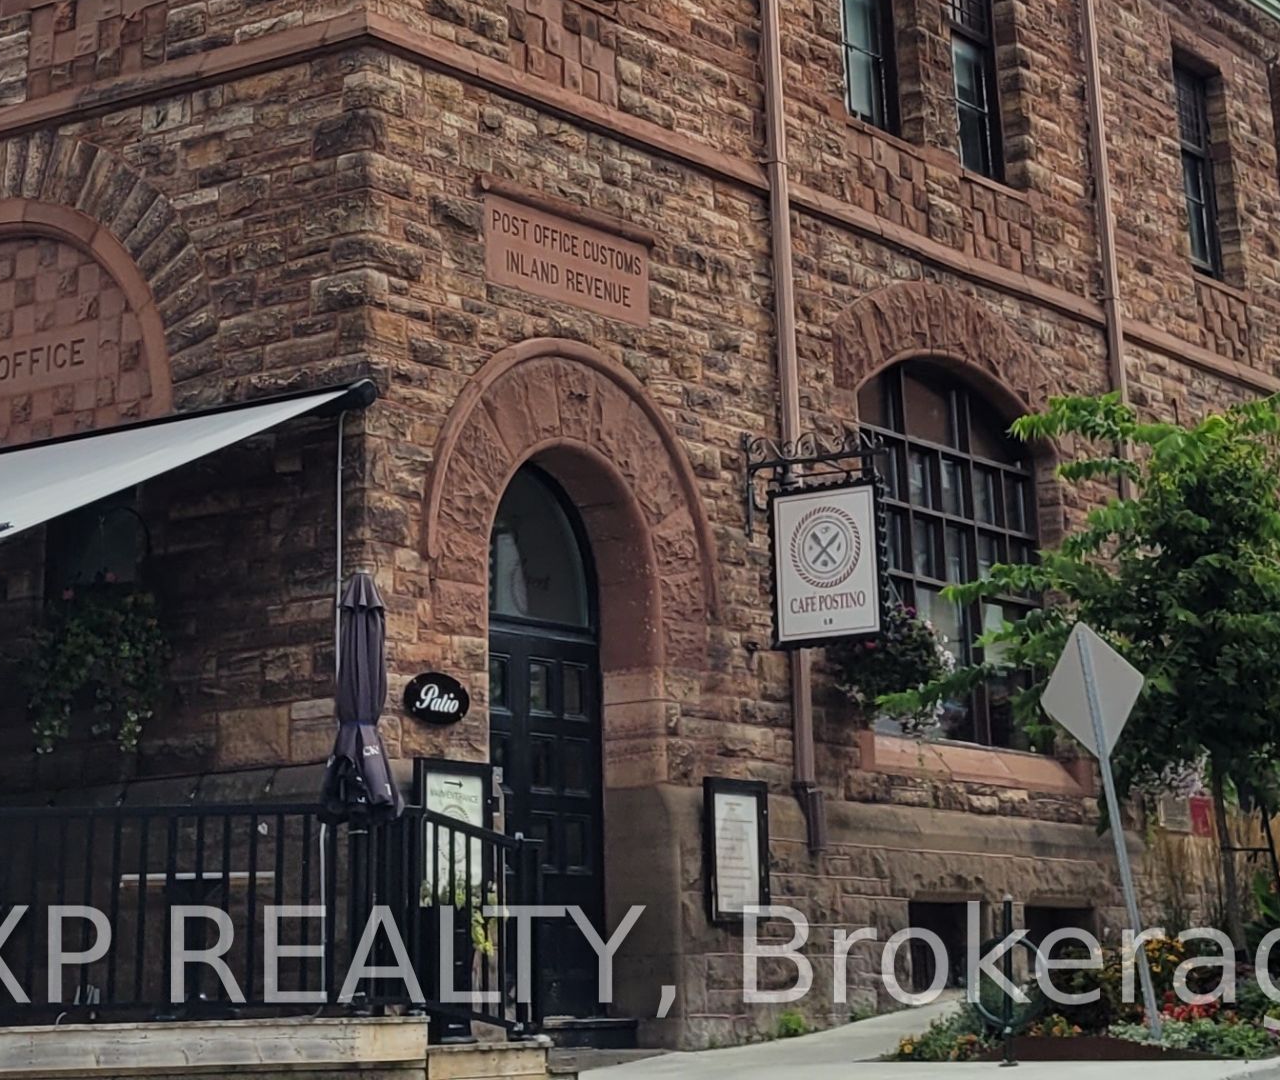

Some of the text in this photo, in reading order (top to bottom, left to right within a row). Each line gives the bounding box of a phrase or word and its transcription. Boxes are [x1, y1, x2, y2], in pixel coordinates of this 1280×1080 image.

[491, 209, 642, 276] POST OFFICE CUSTOMS
[506, 249, 631, 308] INLAND REVENUE
[818, 590, 866, 612] POSTINO
[415, 683, 459, 714] Patio
